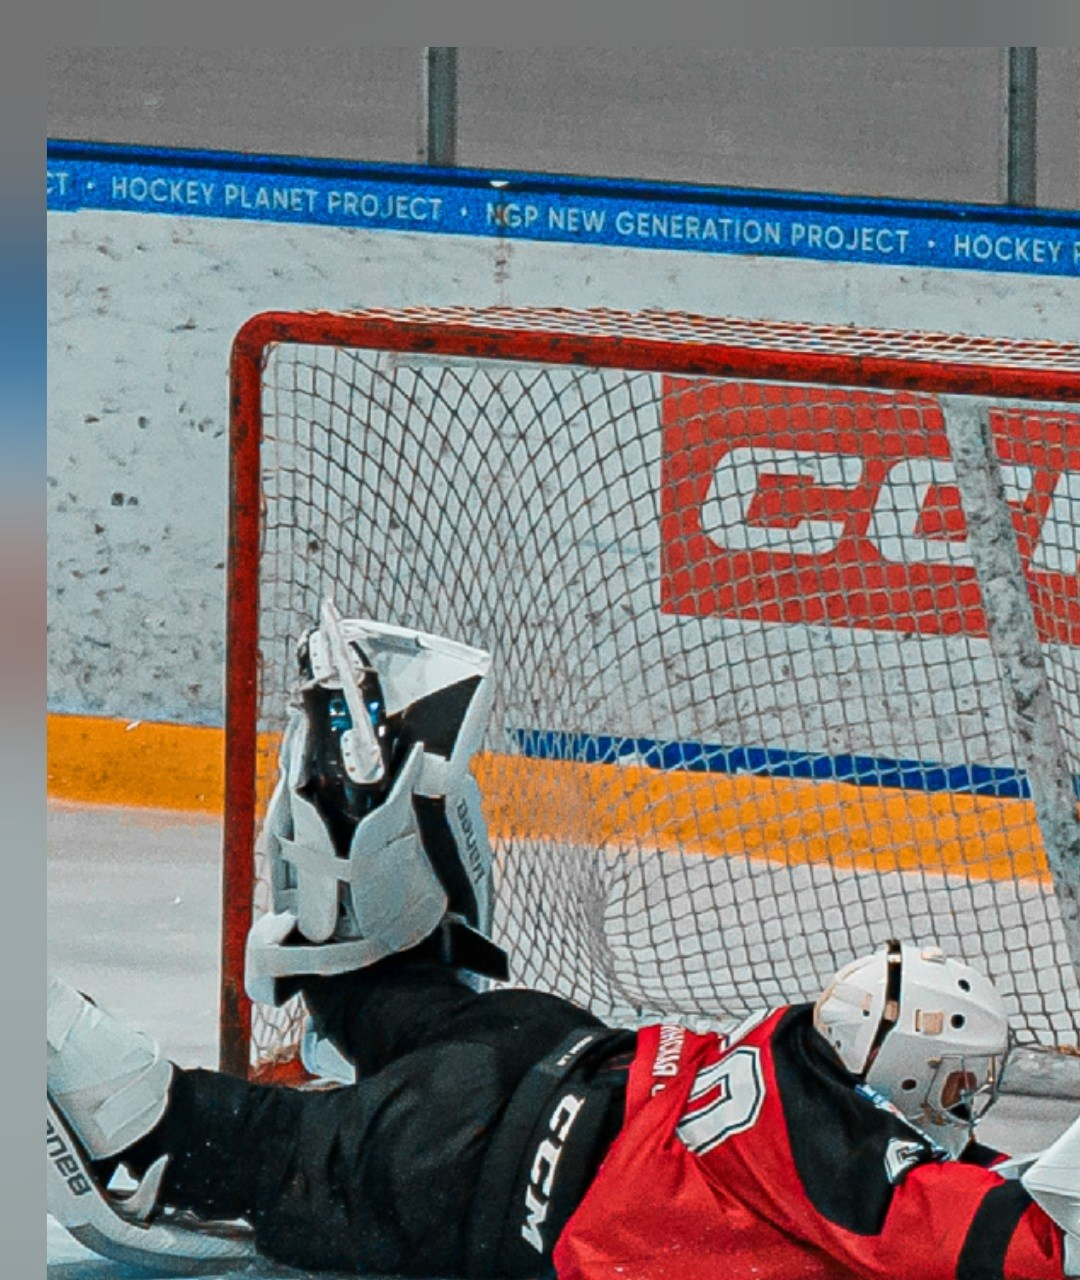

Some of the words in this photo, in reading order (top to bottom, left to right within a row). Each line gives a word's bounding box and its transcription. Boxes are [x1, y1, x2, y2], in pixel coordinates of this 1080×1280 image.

[112, 176, 214, 205] HOCKEY
[225, 183, 318, 212] PLANET
[328, 191, 443, 220] PROJECT
[486, 202, 538, 228] NGP
[548, 206, 605, 232] NEW
[616, 211, 781, 244] GENERATION
[791, 223, 909, 254] PROJECT
[953, 233, 1061, 264] HOCKEY
[521, 1093, 586, 1255] CCM
